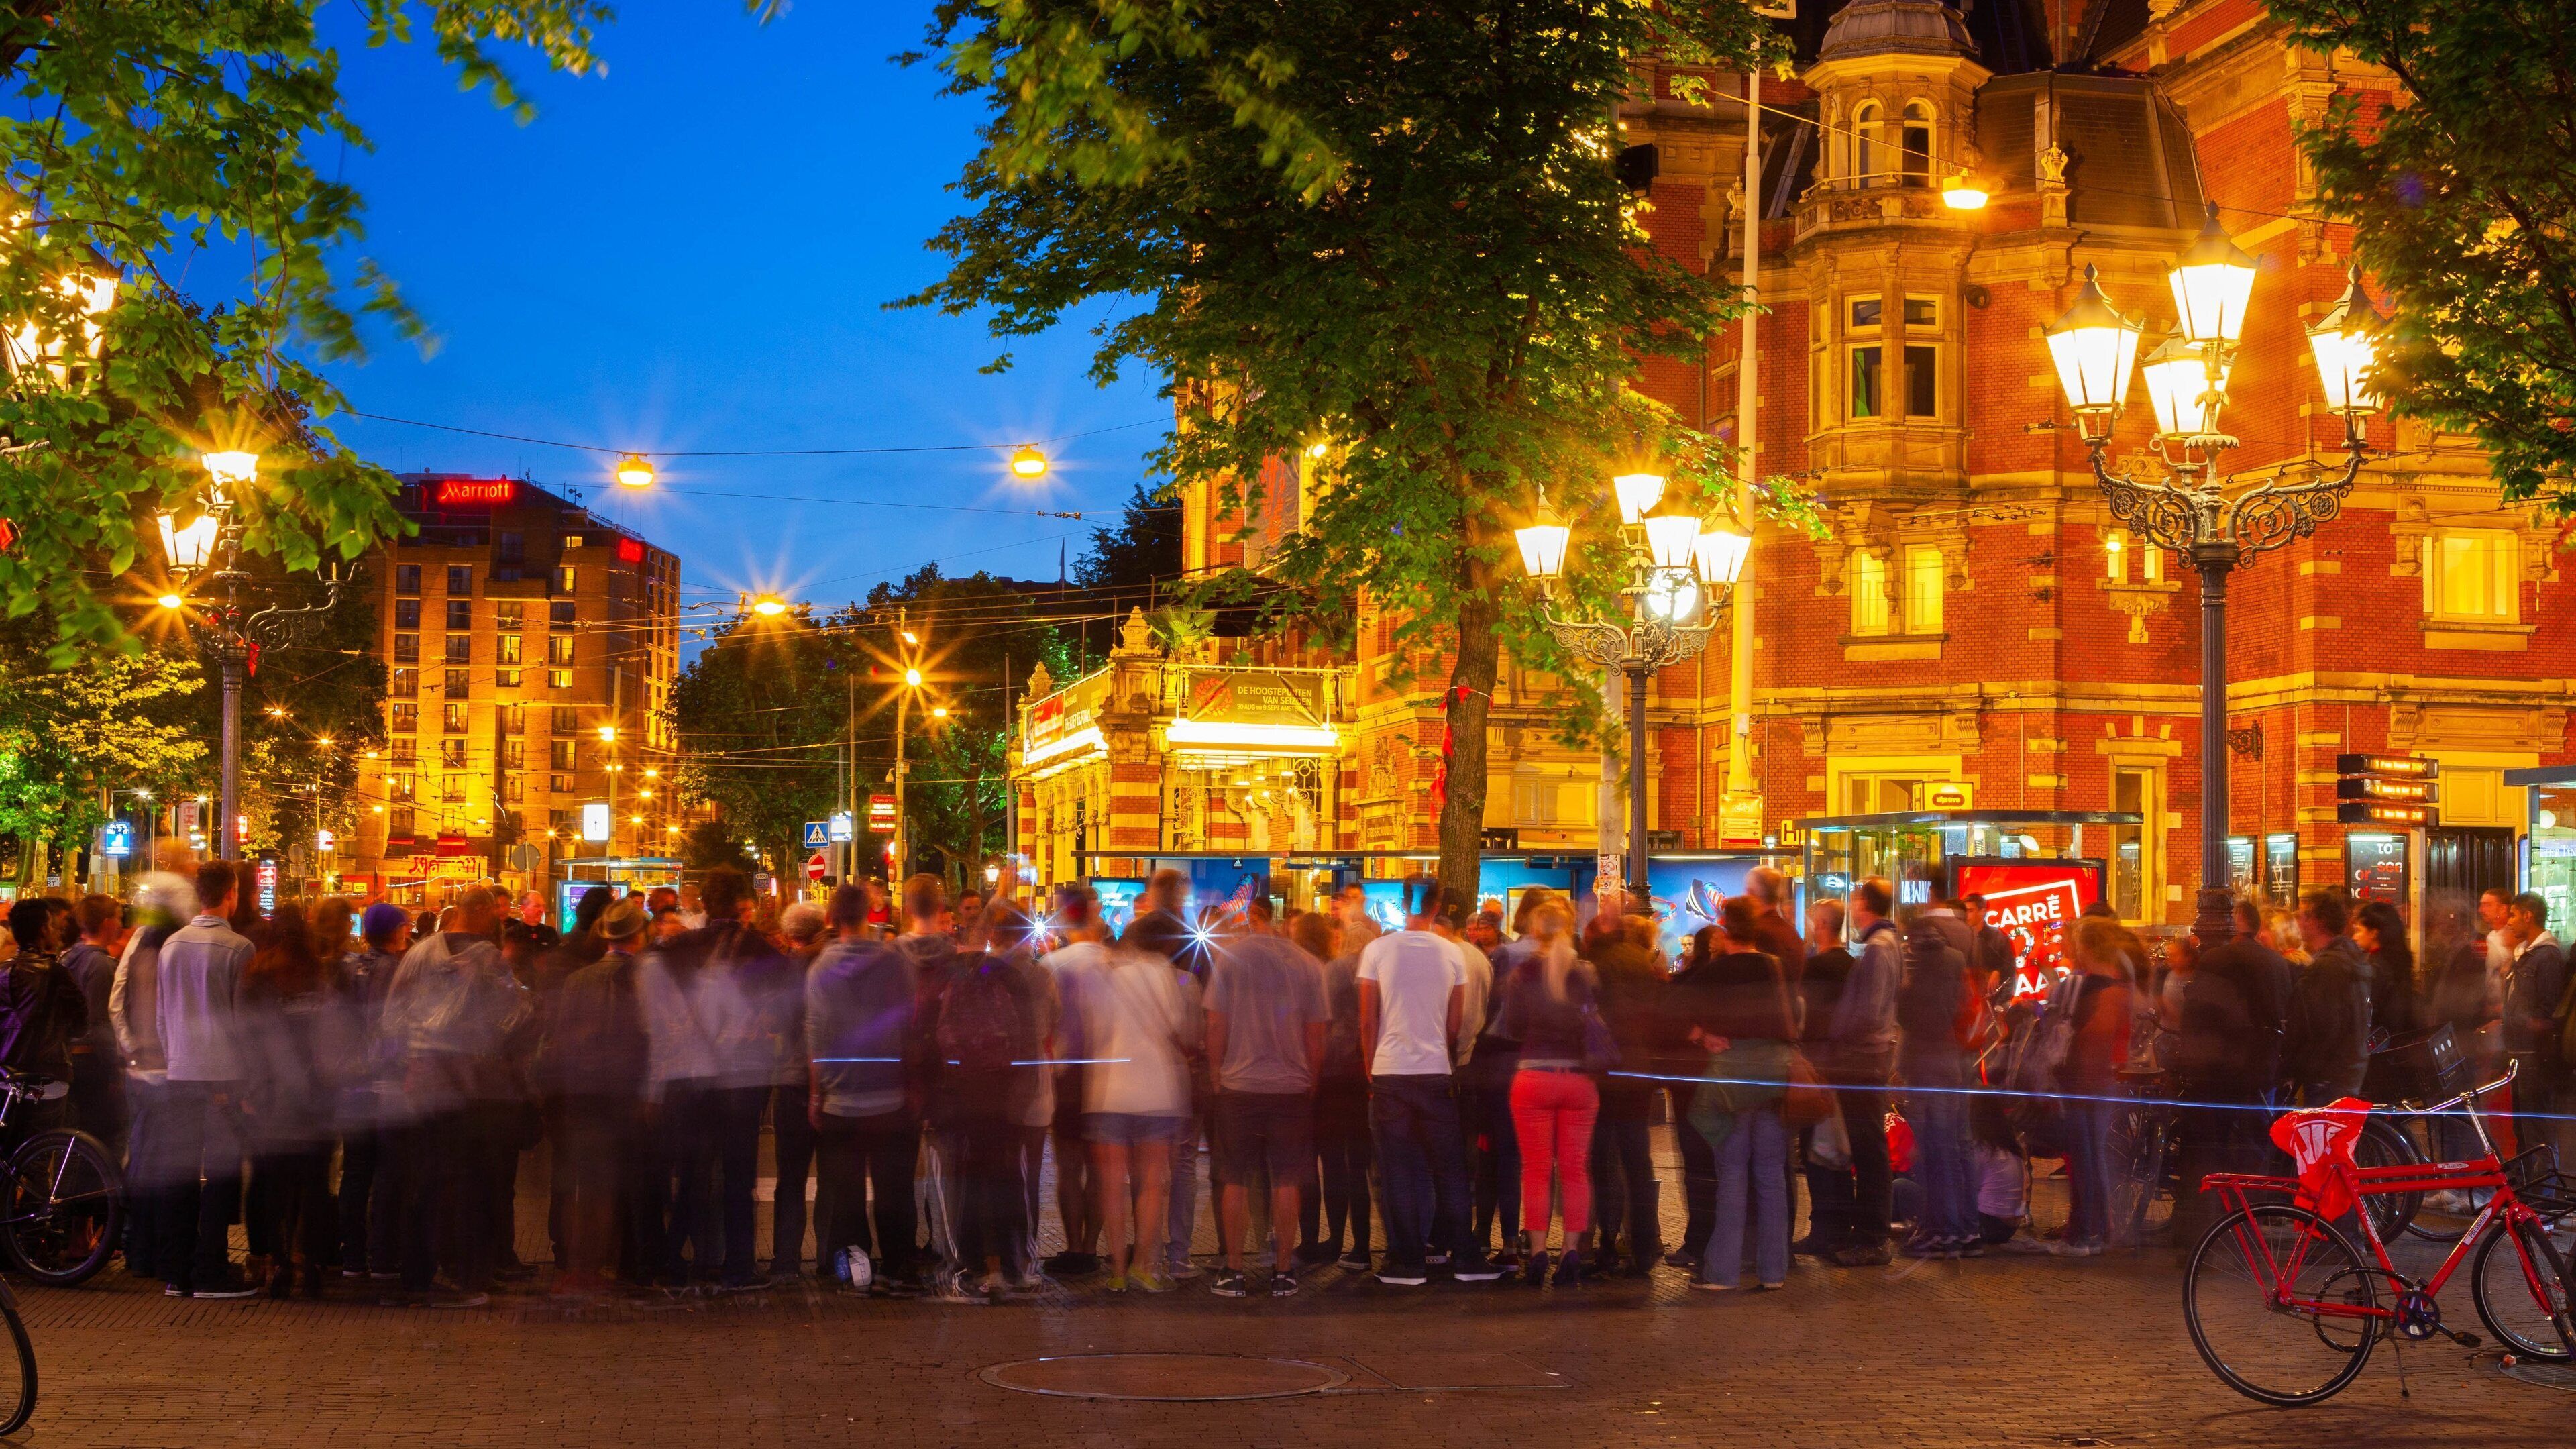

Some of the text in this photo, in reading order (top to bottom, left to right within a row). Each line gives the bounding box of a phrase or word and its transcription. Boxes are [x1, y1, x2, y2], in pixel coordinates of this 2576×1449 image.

[441, 482, 509, 500] Marriott
[1237, 686, 1312, 698] DE HOOGTEPUNTEN
[1263, 696, 1312, 706] VAN SEIZOEN
[2376, 843, 2393, 855] to
[2355, 869, 2371, 881] or
[2468, 1213, 2489, 1239] PRESIDENT
